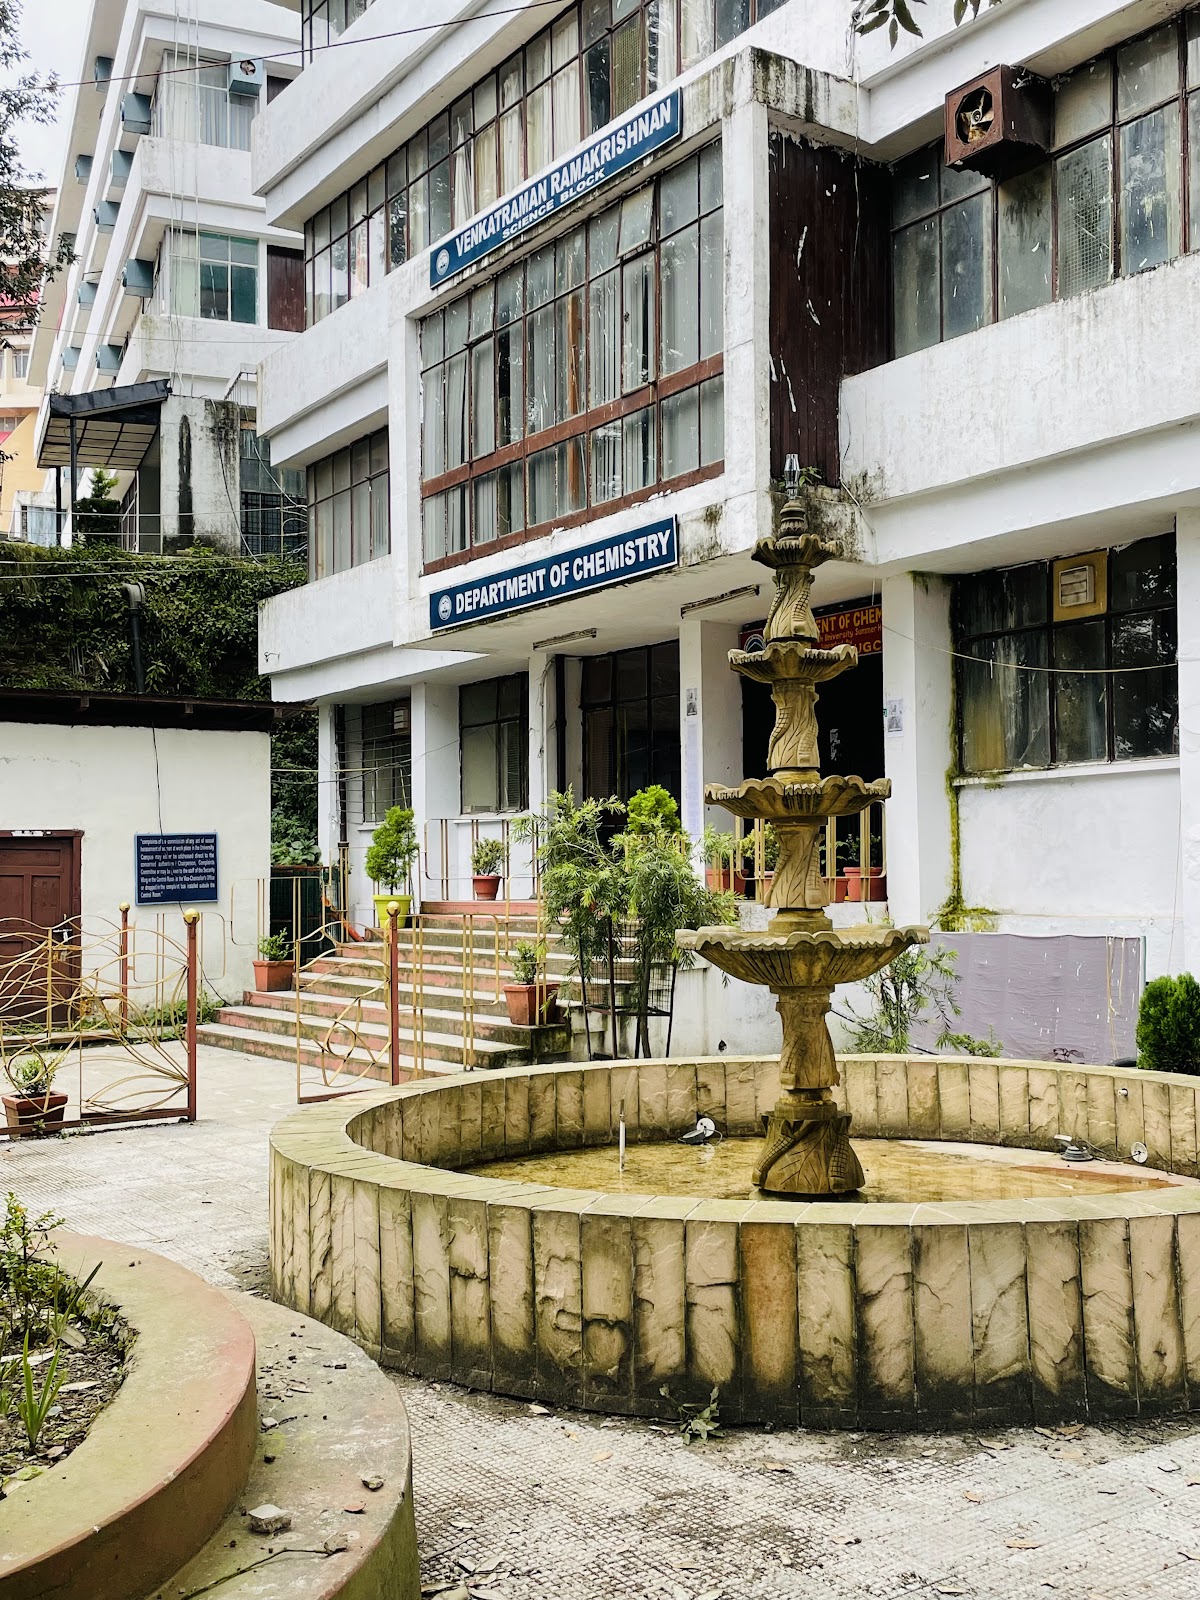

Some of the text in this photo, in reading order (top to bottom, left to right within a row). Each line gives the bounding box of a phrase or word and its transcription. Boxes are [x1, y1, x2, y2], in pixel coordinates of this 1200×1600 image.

[455, 98, 671, 257] VENKATRAMAN RAMAKRISHNAN
[502, 168, 605, 239] SCIENCE BLOCK
[455, 568, 546, 615] DEPARTMENT
[549, 561, 570, 588] OF
[572, 529, 671, 581] CHEMISTRY
[839, 613, 850, 629] OF
[854, 607, 882, 626] CHEM
[855, 626, 877, 636] Summer
